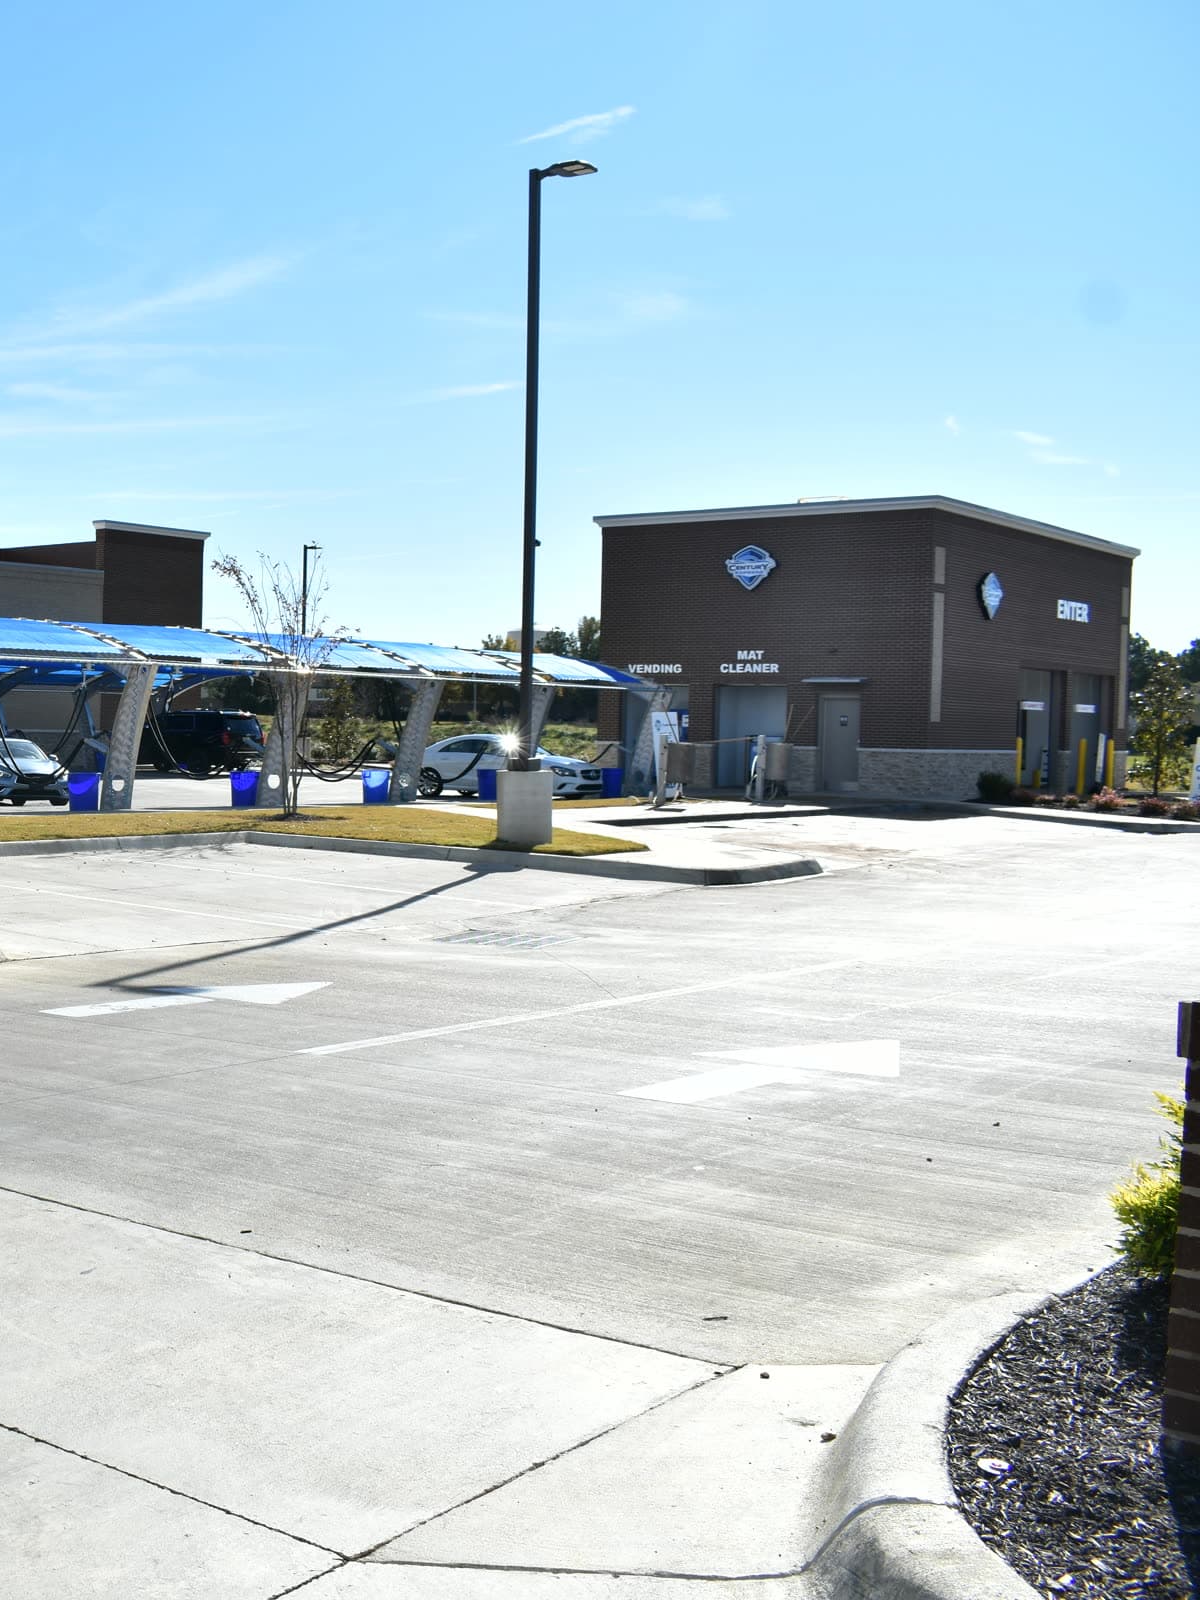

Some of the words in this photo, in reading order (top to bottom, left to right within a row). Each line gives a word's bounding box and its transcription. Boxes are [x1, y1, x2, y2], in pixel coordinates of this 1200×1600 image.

[1057, 599, 1089, 623] ENTER
[737, 650, 764, 660] MAT
[628, 664, 682, 674] VENDING
[720, 663, 780, 673] CLEANER
